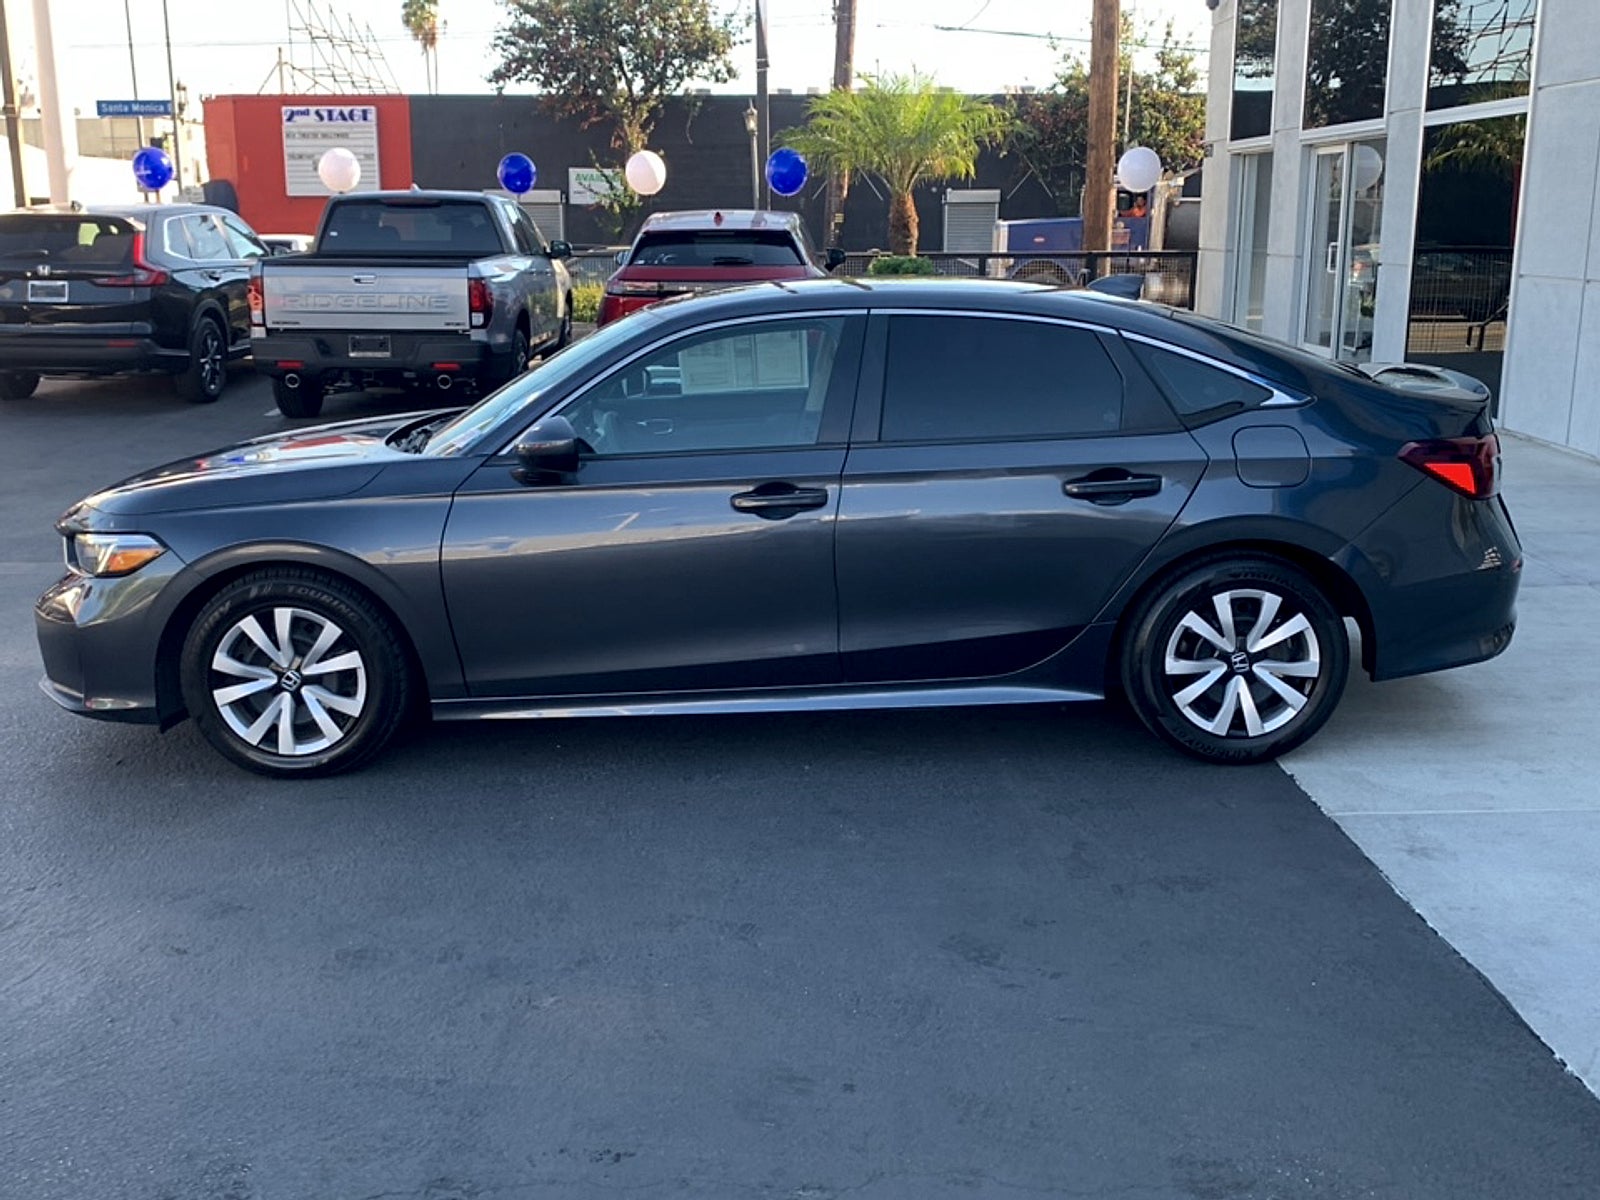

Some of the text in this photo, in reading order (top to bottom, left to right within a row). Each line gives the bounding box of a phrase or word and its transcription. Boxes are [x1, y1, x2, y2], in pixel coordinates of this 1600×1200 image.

[101, 103, 128, 113] Santa
[131, 103, 164, 113] Monica
[284, 108, 373, 122] 2nd STAGE
[281, 294, 450, 309] RIDGELINE
